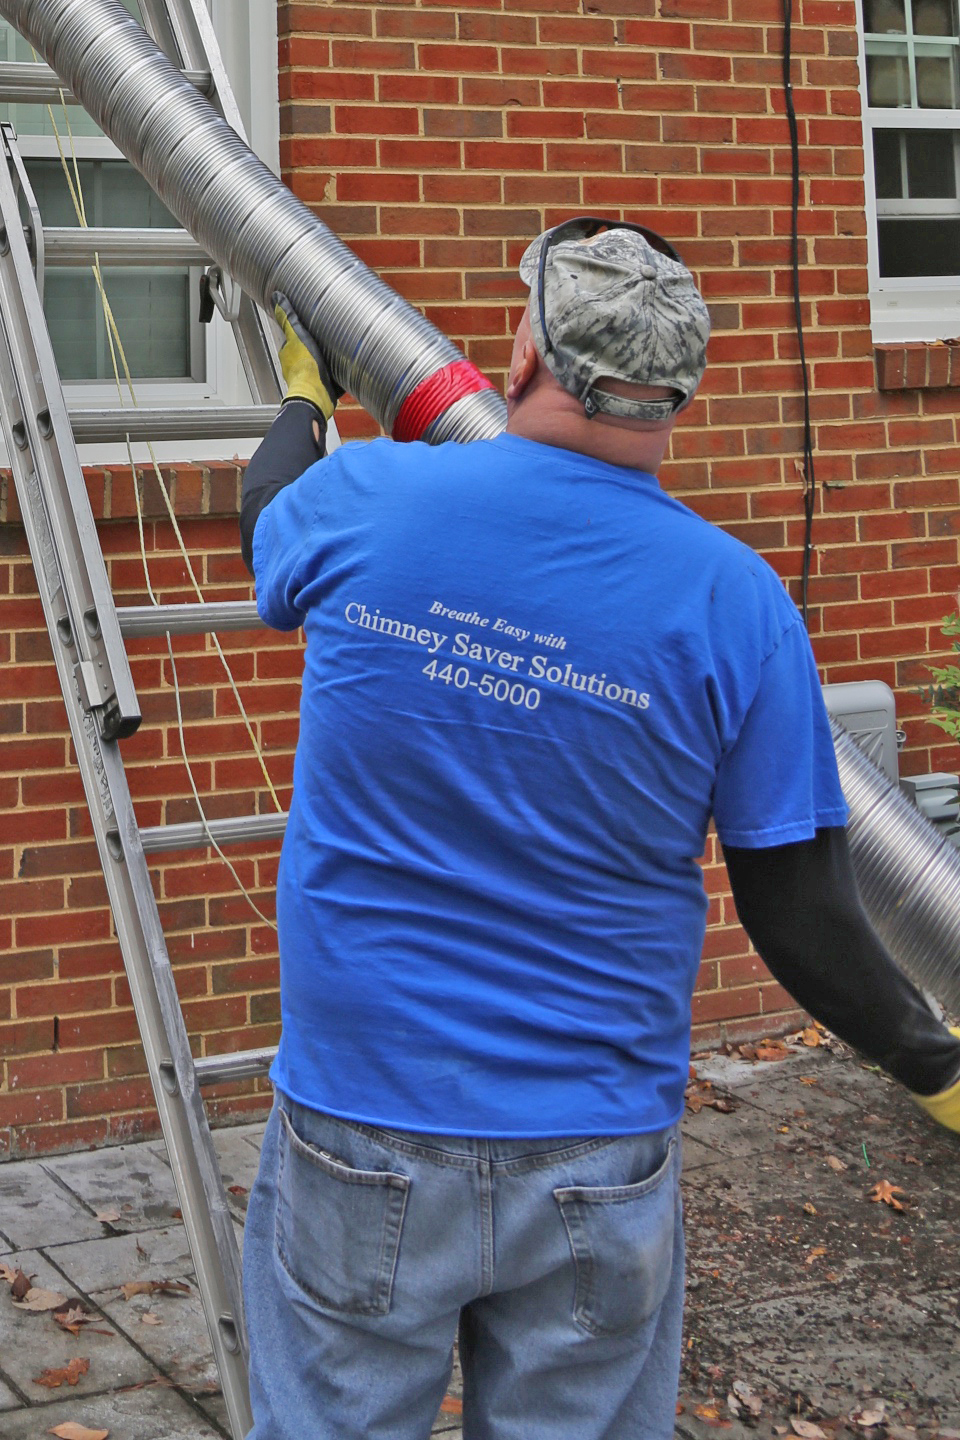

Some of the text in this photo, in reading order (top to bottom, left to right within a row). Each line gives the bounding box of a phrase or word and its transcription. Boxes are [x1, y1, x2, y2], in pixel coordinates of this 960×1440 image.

[428, 600, 567, 650] Breathe Easy with
[344, 602, 651, 710] Chimney Saver Solutions
[421, 659, 541, 711] 440-5000
